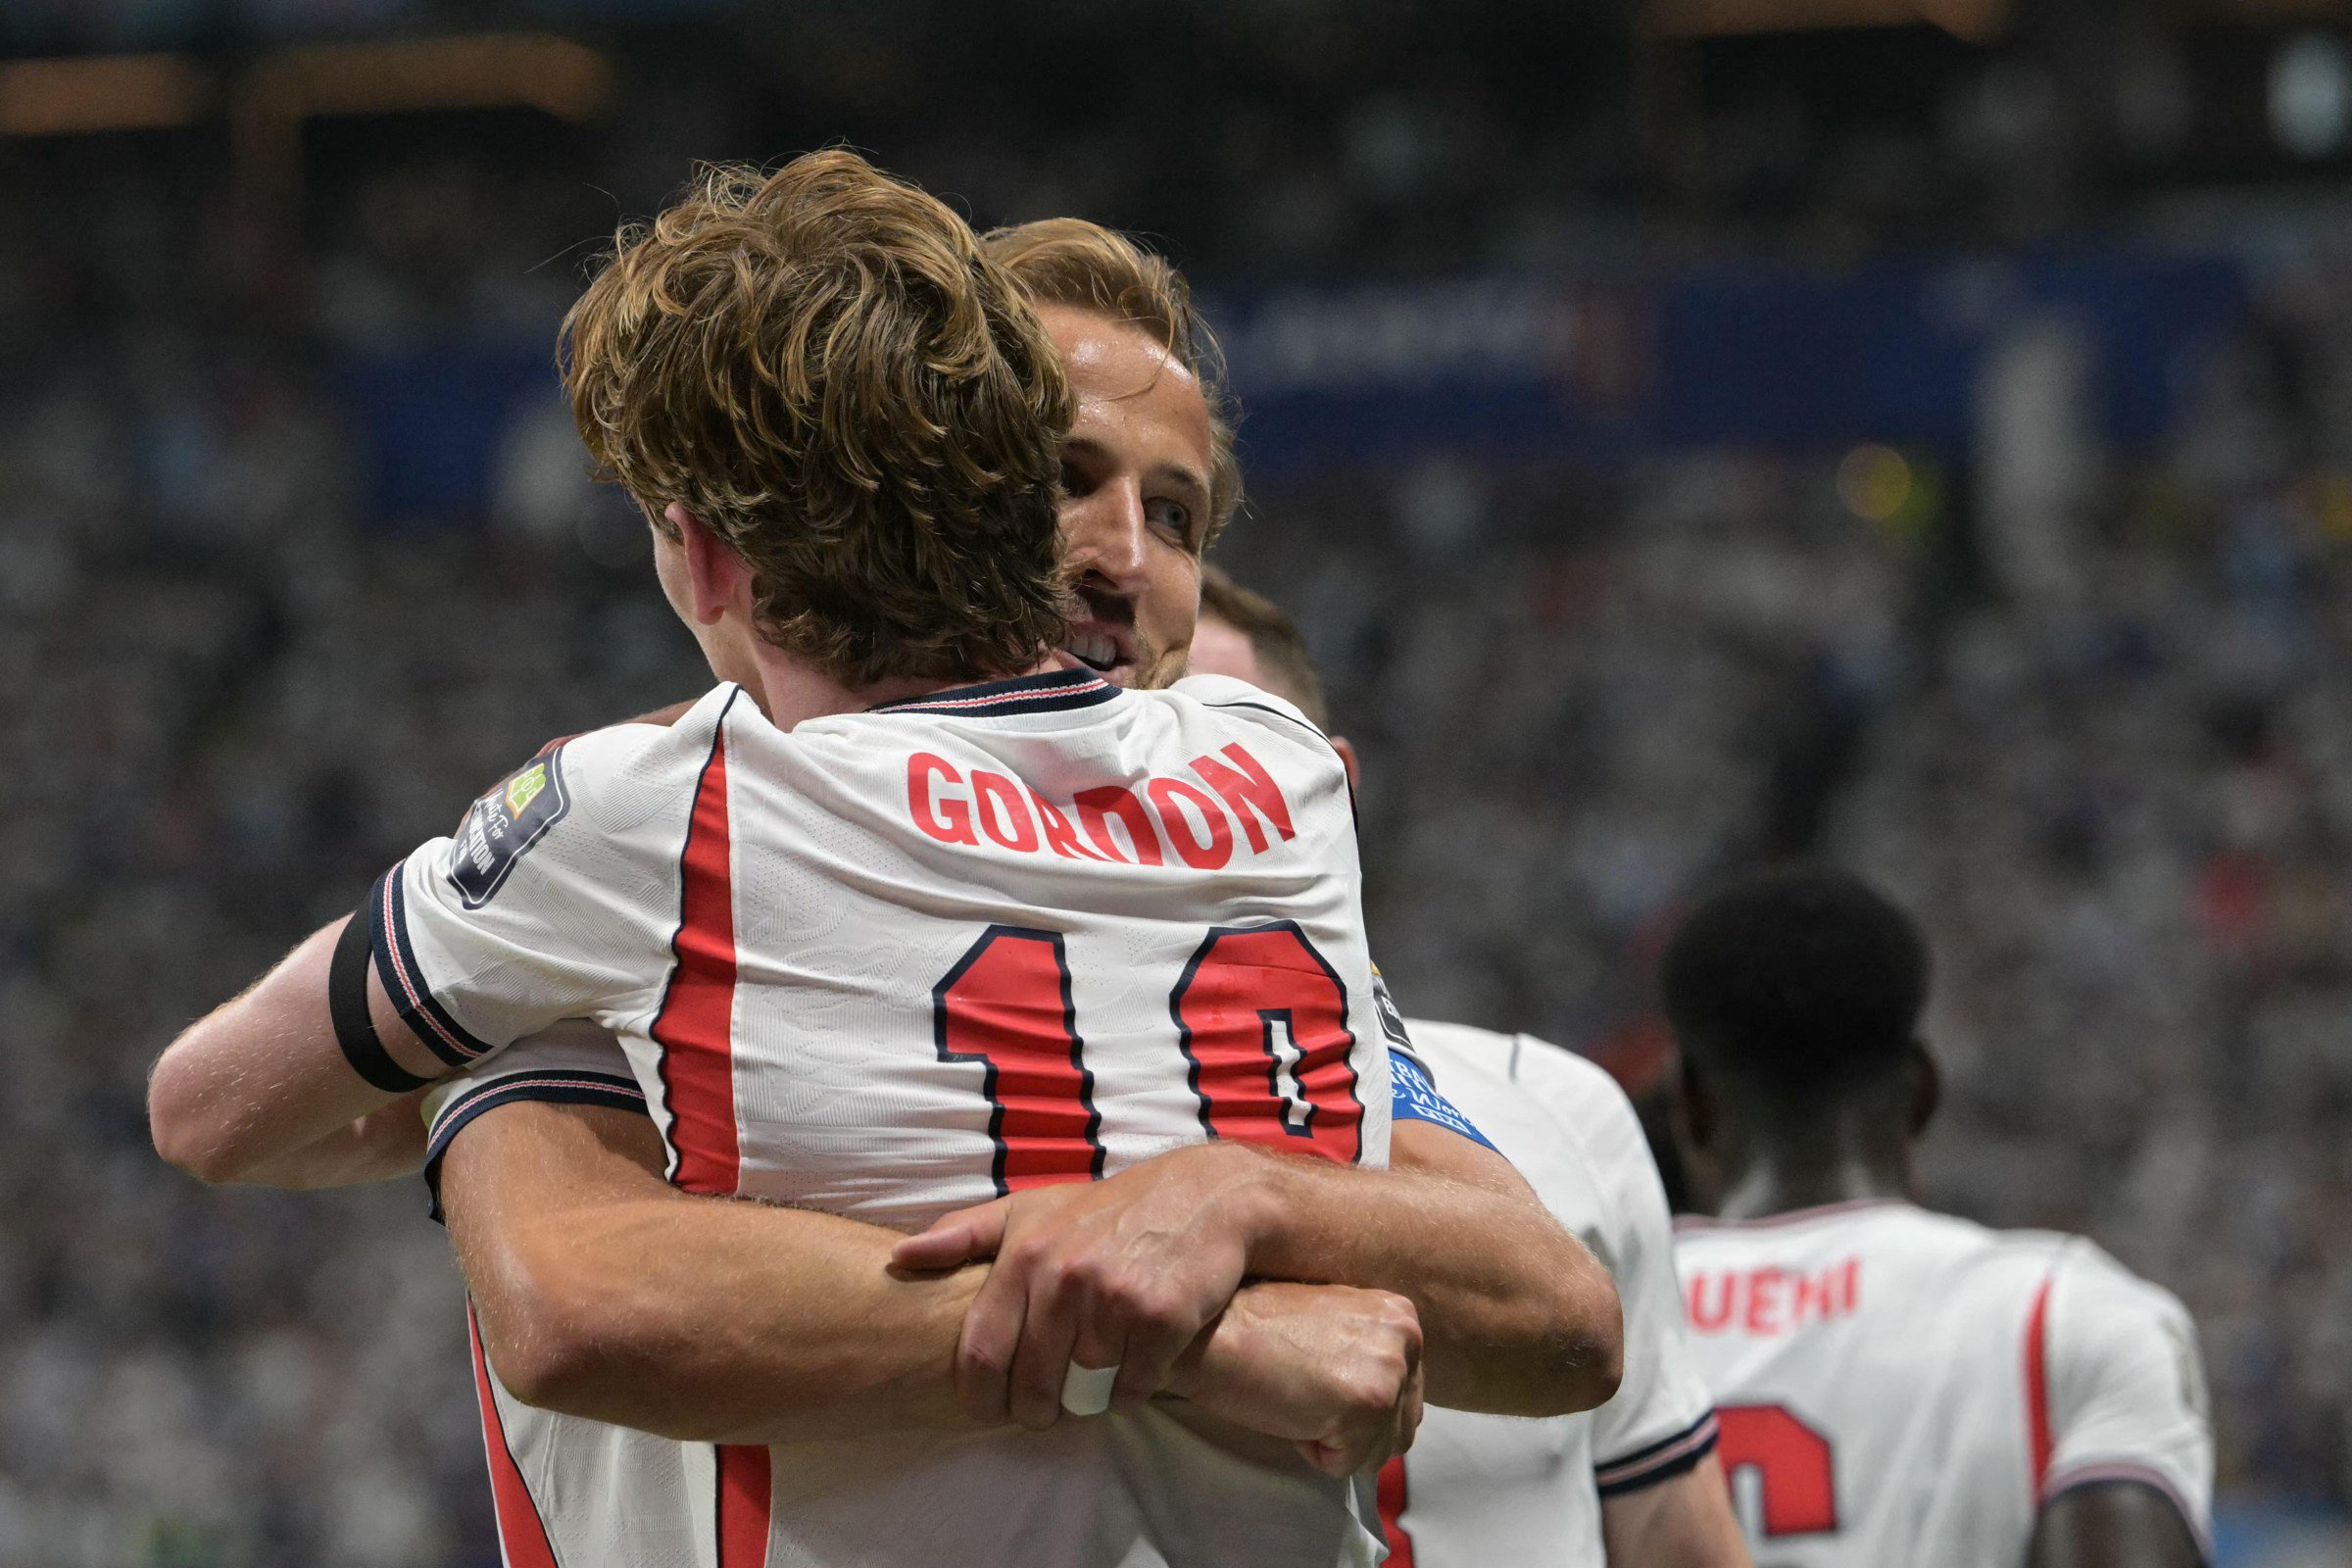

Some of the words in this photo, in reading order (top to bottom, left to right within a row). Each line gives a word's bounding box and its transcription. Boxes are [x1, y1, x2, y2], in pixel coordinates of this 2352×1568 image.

[488, 814, 509, 840] For
[907, 742, 1296, 870] GORDON
[932, 919, 1364, 1196] 10
